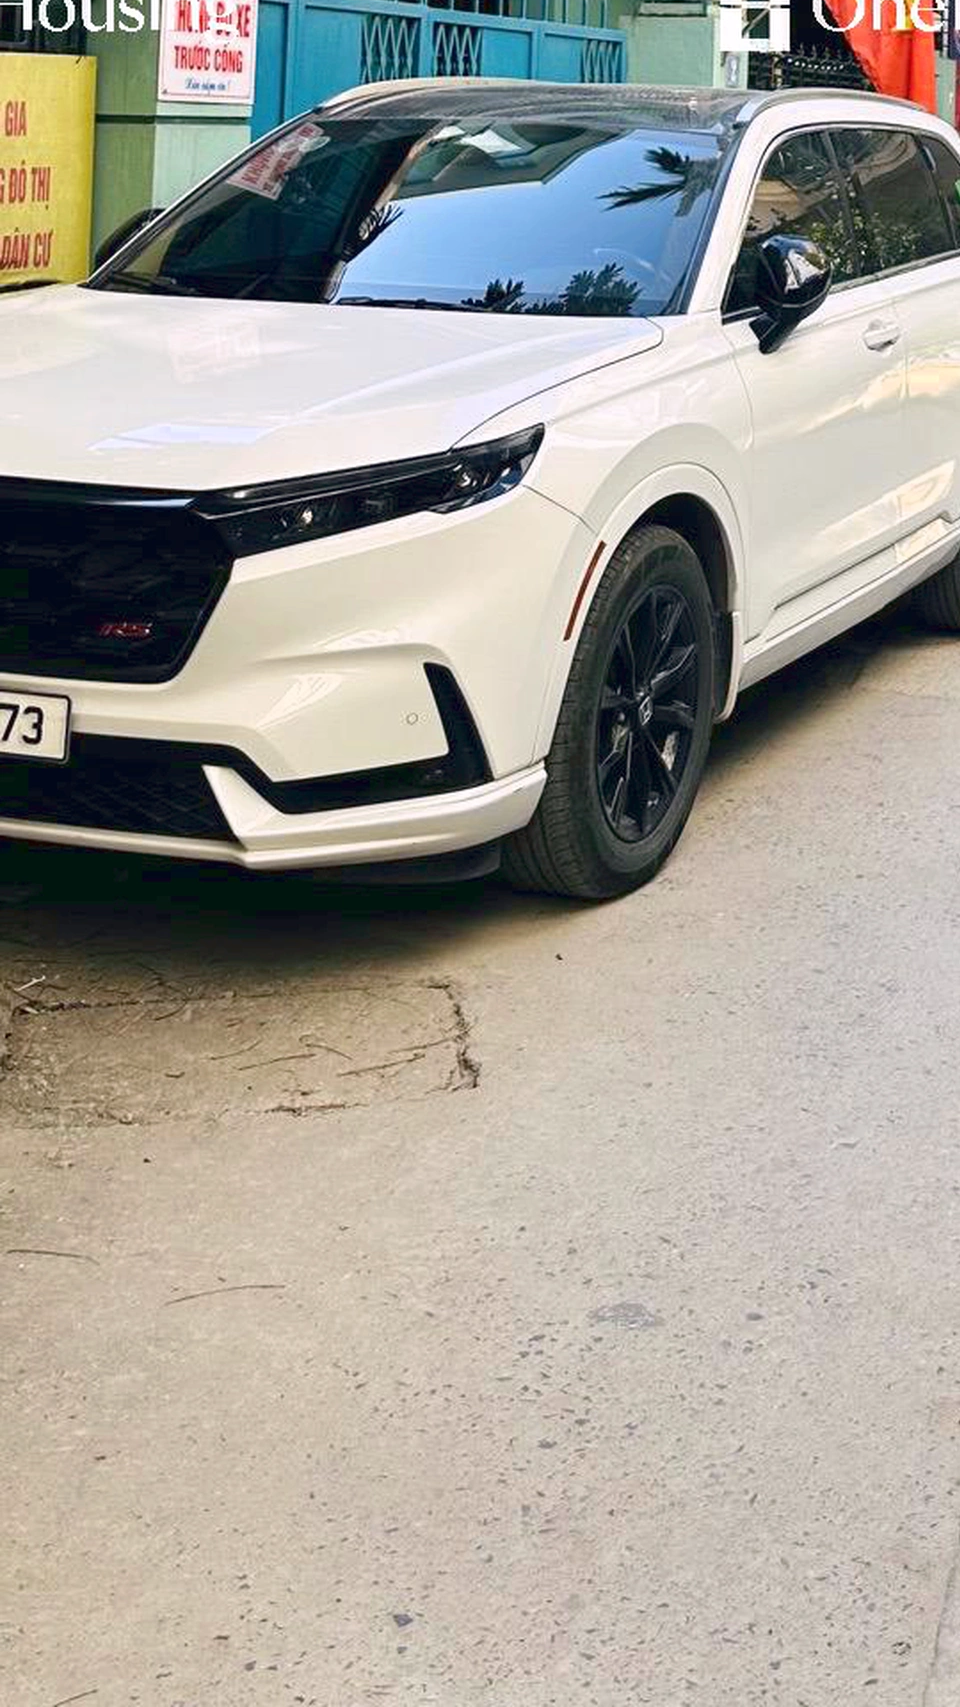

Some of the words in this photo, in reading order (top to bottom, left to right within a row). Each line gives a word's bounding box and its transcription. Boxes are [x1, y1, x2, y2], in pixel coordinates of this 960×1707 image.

[174, 41, 210, 70] TRƯỚC
[4, 100, 27, 137] GIA
[31, 166, 51, 211] THỊ
[0, 227, 30, 270] DÂN
[33, 228, 53, 268] CƯ
